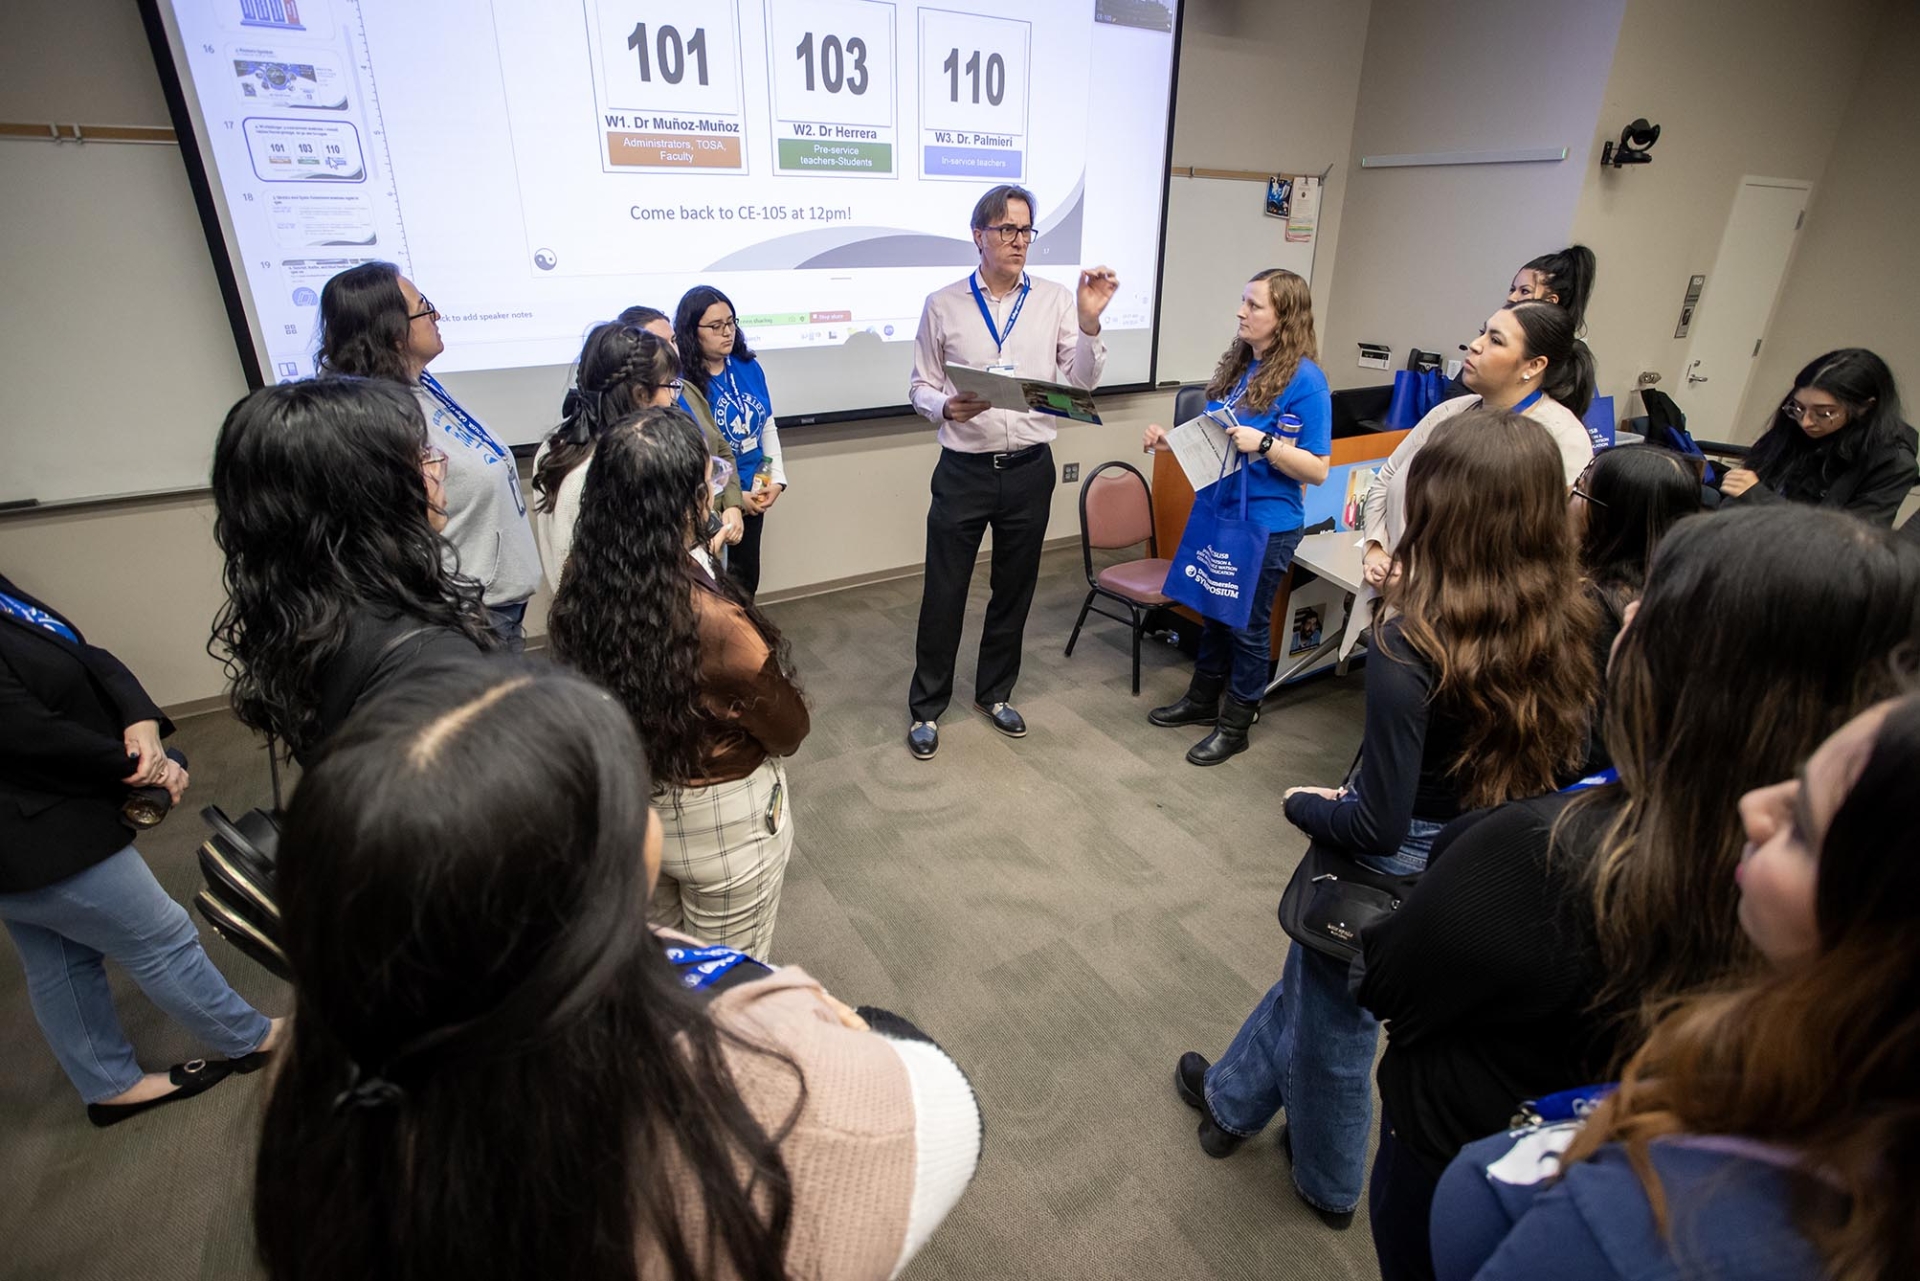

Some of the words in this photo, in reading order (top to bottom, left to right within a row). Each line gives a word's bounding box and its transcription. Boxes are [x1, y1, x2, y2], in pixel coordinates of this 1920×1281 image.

[203, 43, 215, 55] 16
[627, 22, 709, 86] 101
[796, 31, 869, 96] 103
[944, 47, 1006, 107] 110
[223, 120, 234, 130] 17
[605, 115, 631, 129] W1.
[634, 116, 650, 130] Dr
[652, 117, 740, 133] Muñoz-Muñoz
[793, 123, 816, 136] W2.
[819, 124, 833, 137] Dr
[834, 125, 877, 140] Herrera
[623, 137, 694, 151] Administrators,
[695, 139, 727, 151] TOSA,
[935, 132, 955, 144] W3.
[956, 133, 971, 145] Dr.
[973, 135, 1013, 147] Palmieri
[270, 143, 285, 153] 101
[298, 143, 313, 153] 103
[325, 144, 341, 154] 110
[814, 144, 860, 155] Pre-service
[659, 151, 694, 163] Faculty
[800, 155, 873, 167] teachers-Students
[941, 156, 975, 166] In-service
[976, 157, 1006, 168] teachers
[242, 193, 254, 202] 18
[630, 205, 676, 220] Come
[680, 205, 715, 220] back
[719, 207, 734, 220] to
[738, 206, 787, 220] CE-105
[791, 207, 805, 220] at
[808, 206, 852, 222] 12pm!
[260, 260, 271, 270] 19
[462, 313, 478, 322] add
[479, 312, 509, 322] speaker
[511, 311, 533, 319] notes
